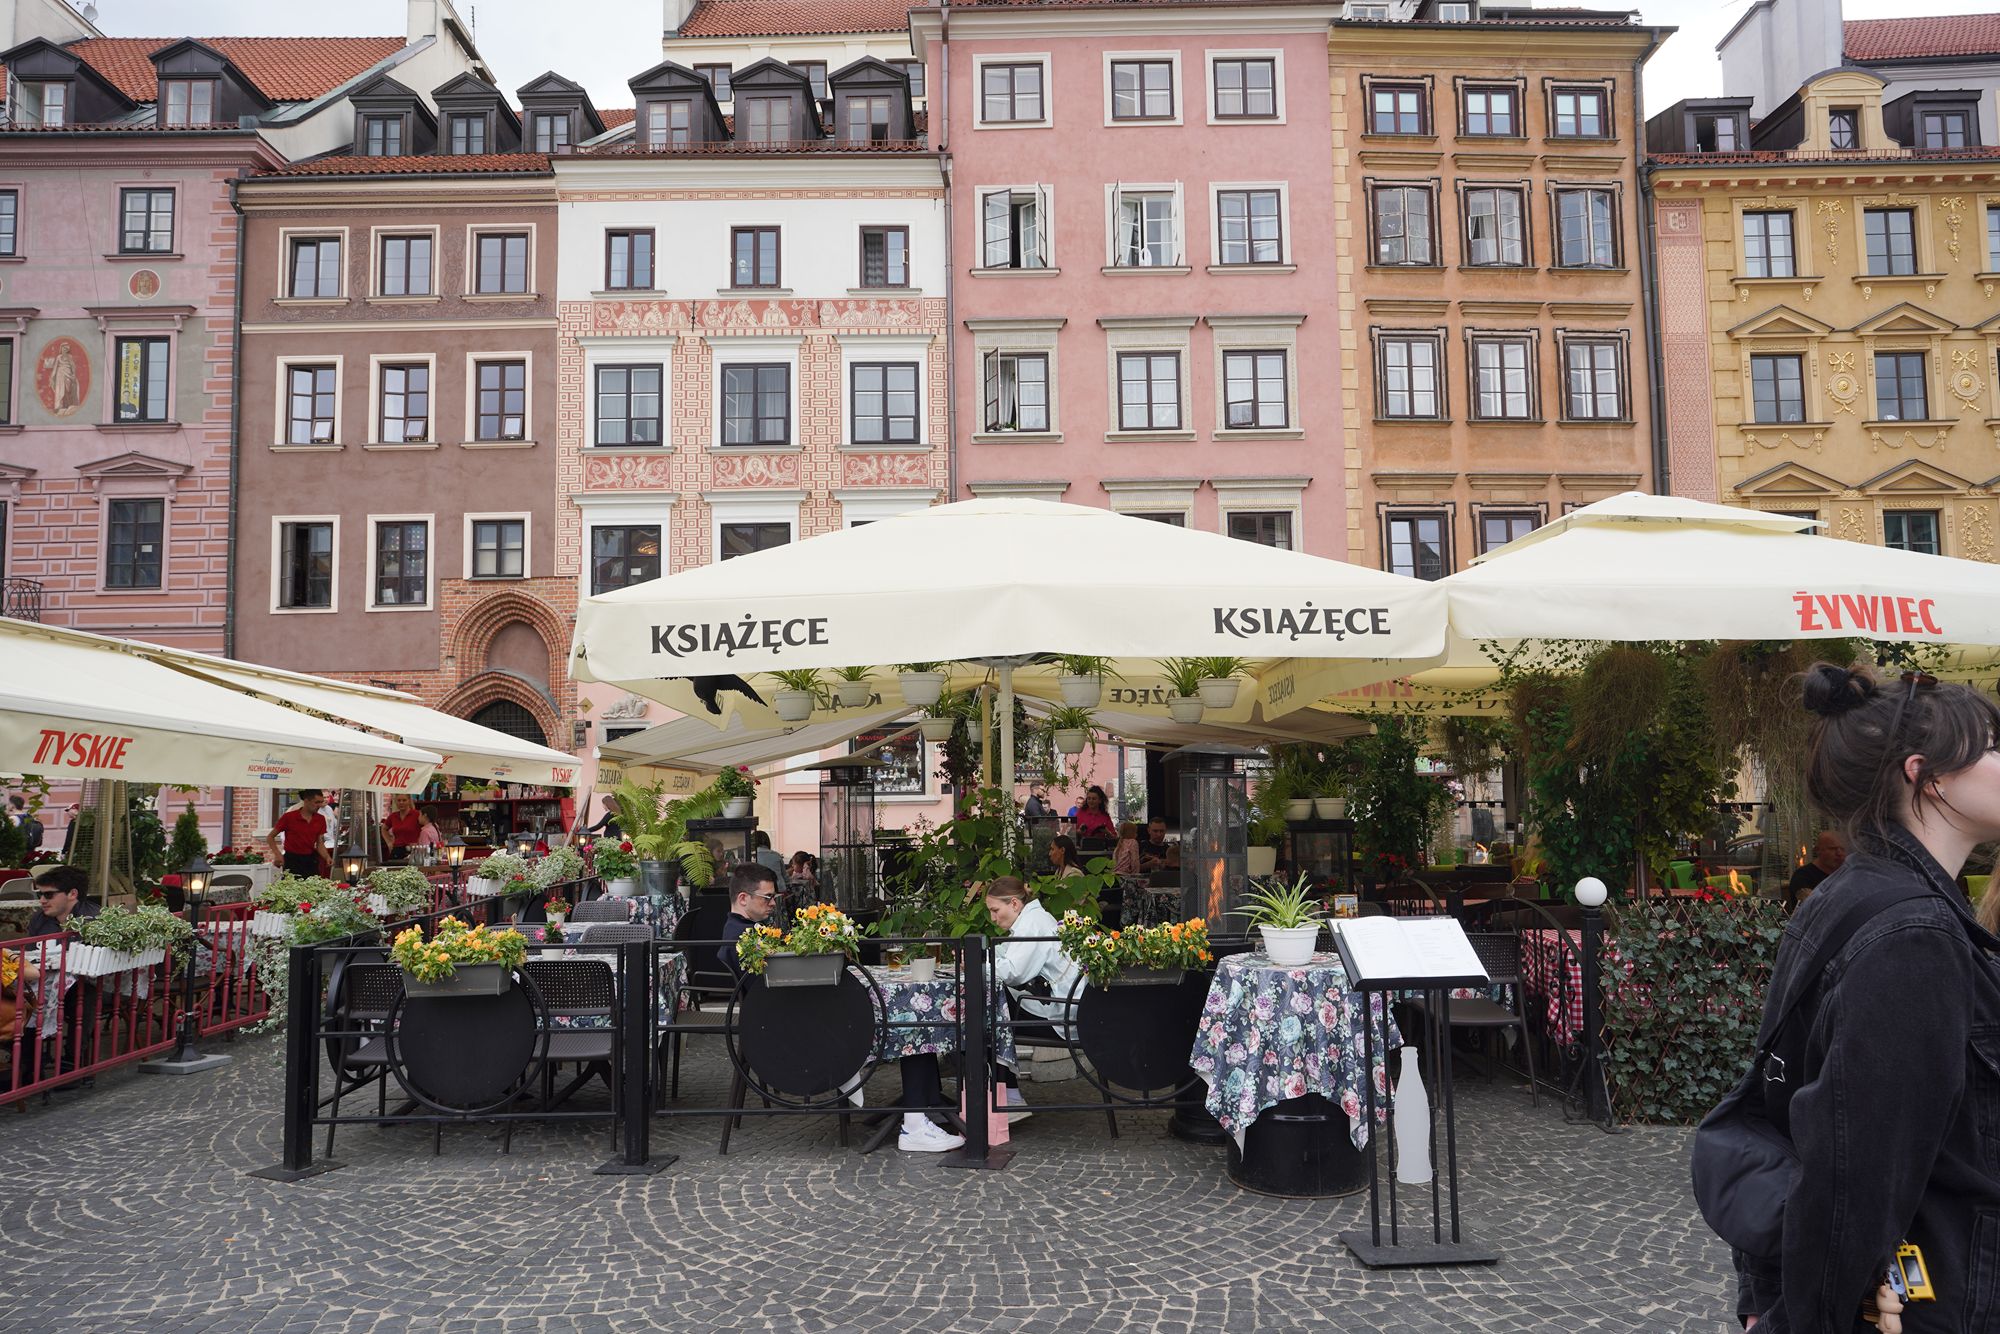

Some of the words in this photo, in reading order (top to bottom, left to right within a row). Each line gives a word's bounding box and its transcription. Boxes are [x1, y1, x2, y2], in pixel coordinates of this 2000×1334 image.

[1213, 601, 1391, 642] KSIĄŻĘCE
[1793, 592, 1942, 635] ŻYWIEC
[651, 613, 829, 658] KSIĄŻĘCE
[32, 729, 133, 770] TYSKIE
[368, 764, 415, 788] TYSKIE
[552, 767, 573, 783] TYSKIE
